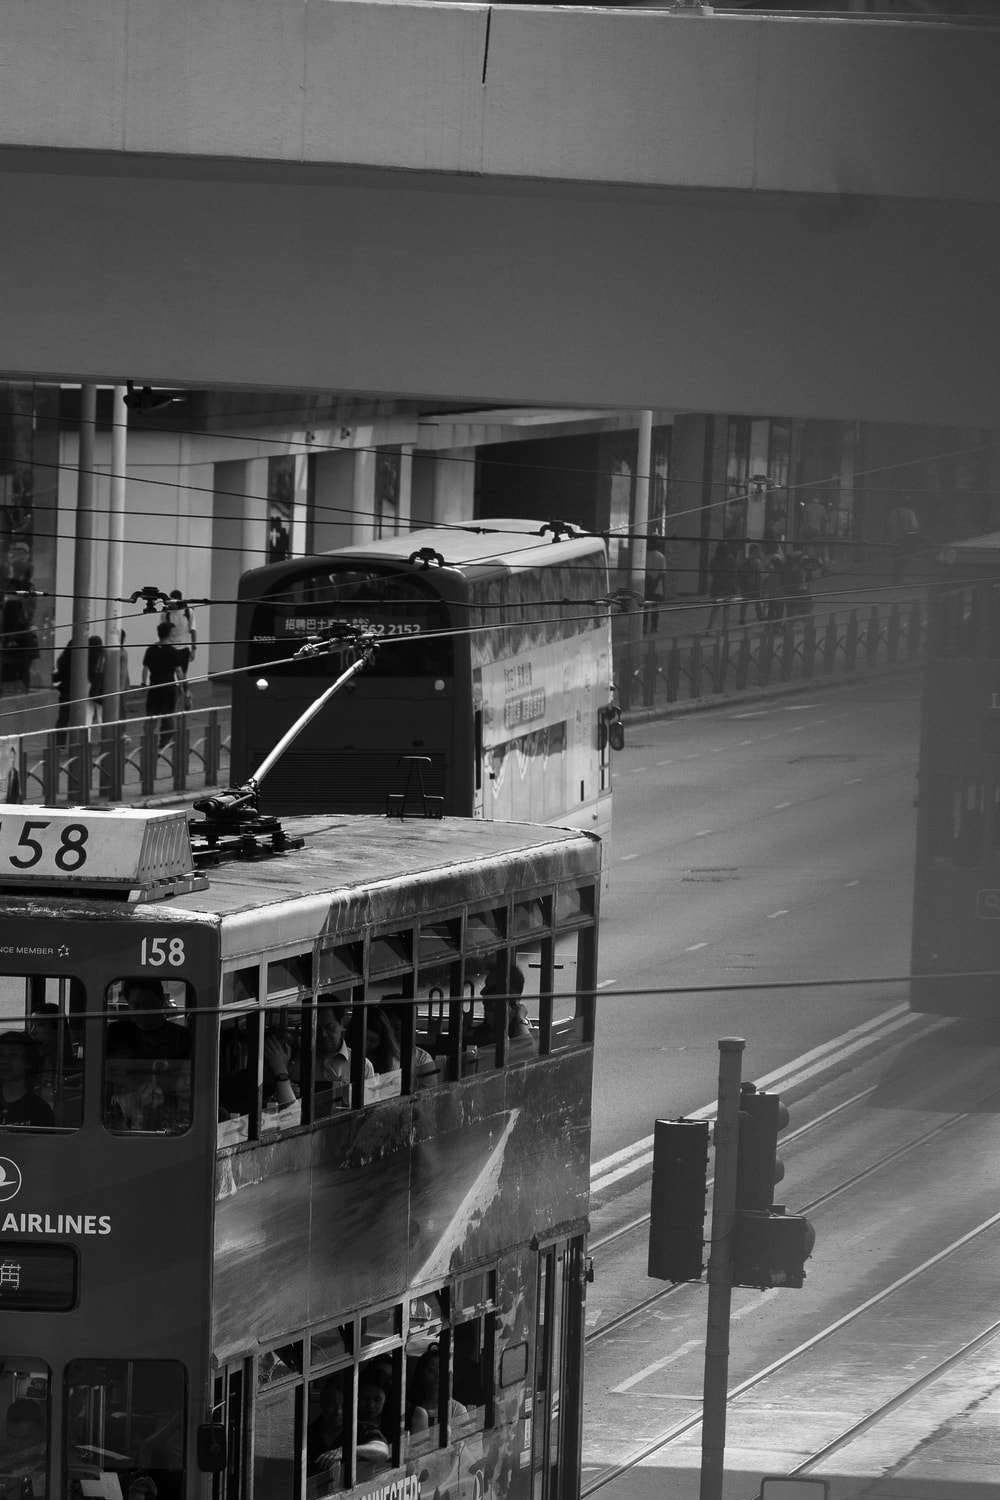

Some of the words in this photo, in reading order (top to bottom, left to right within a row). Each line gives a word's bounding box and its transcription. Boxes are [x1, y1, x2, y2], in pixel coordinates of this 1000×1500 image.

[16, 946, 54, 955] MEMBER
[140, 937, 186, 967] 158
[1, 1212, 112, 1235] AIRLINES
